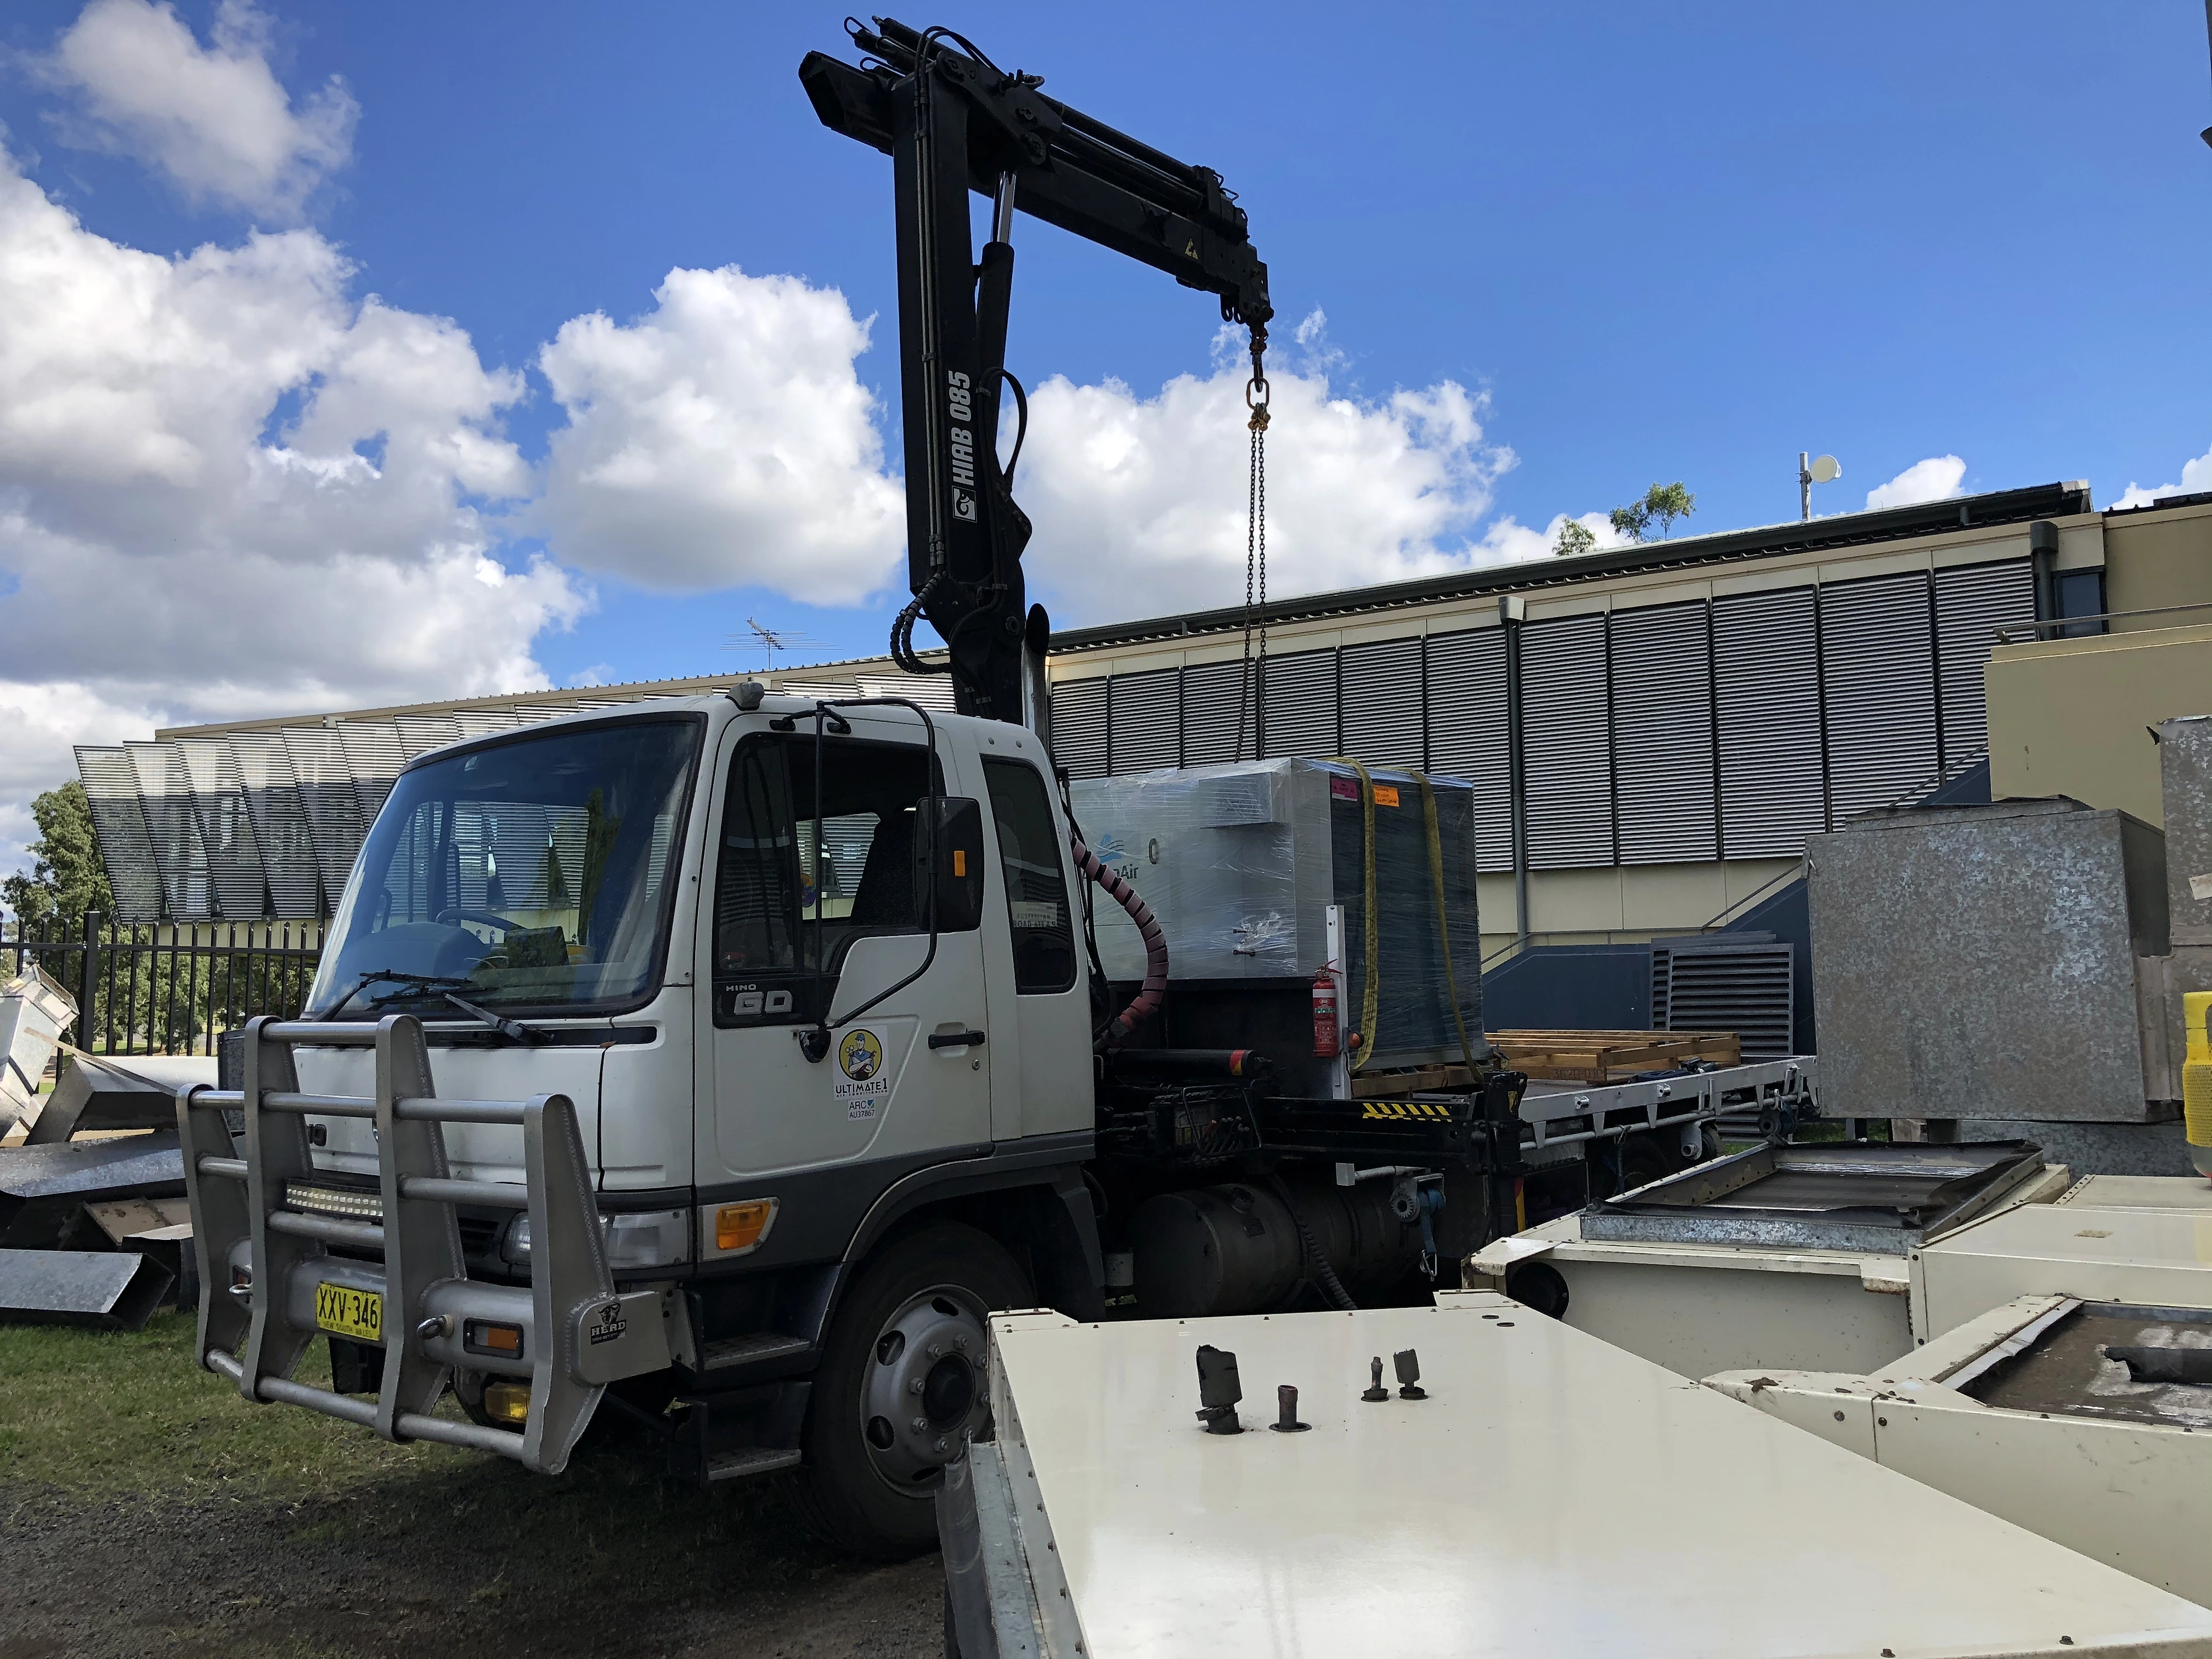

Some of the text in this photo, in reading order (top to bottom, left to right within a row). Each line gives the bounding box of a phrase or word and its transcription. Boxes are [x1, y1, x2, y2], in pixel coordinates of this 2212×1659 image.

[948, 370, 974, 486] HIAB 085
[849, 1100, 867, 1110] ARC
[849, 1109, 875, 1119] AU37867
[591, 1322, 625, 1336] HERD
